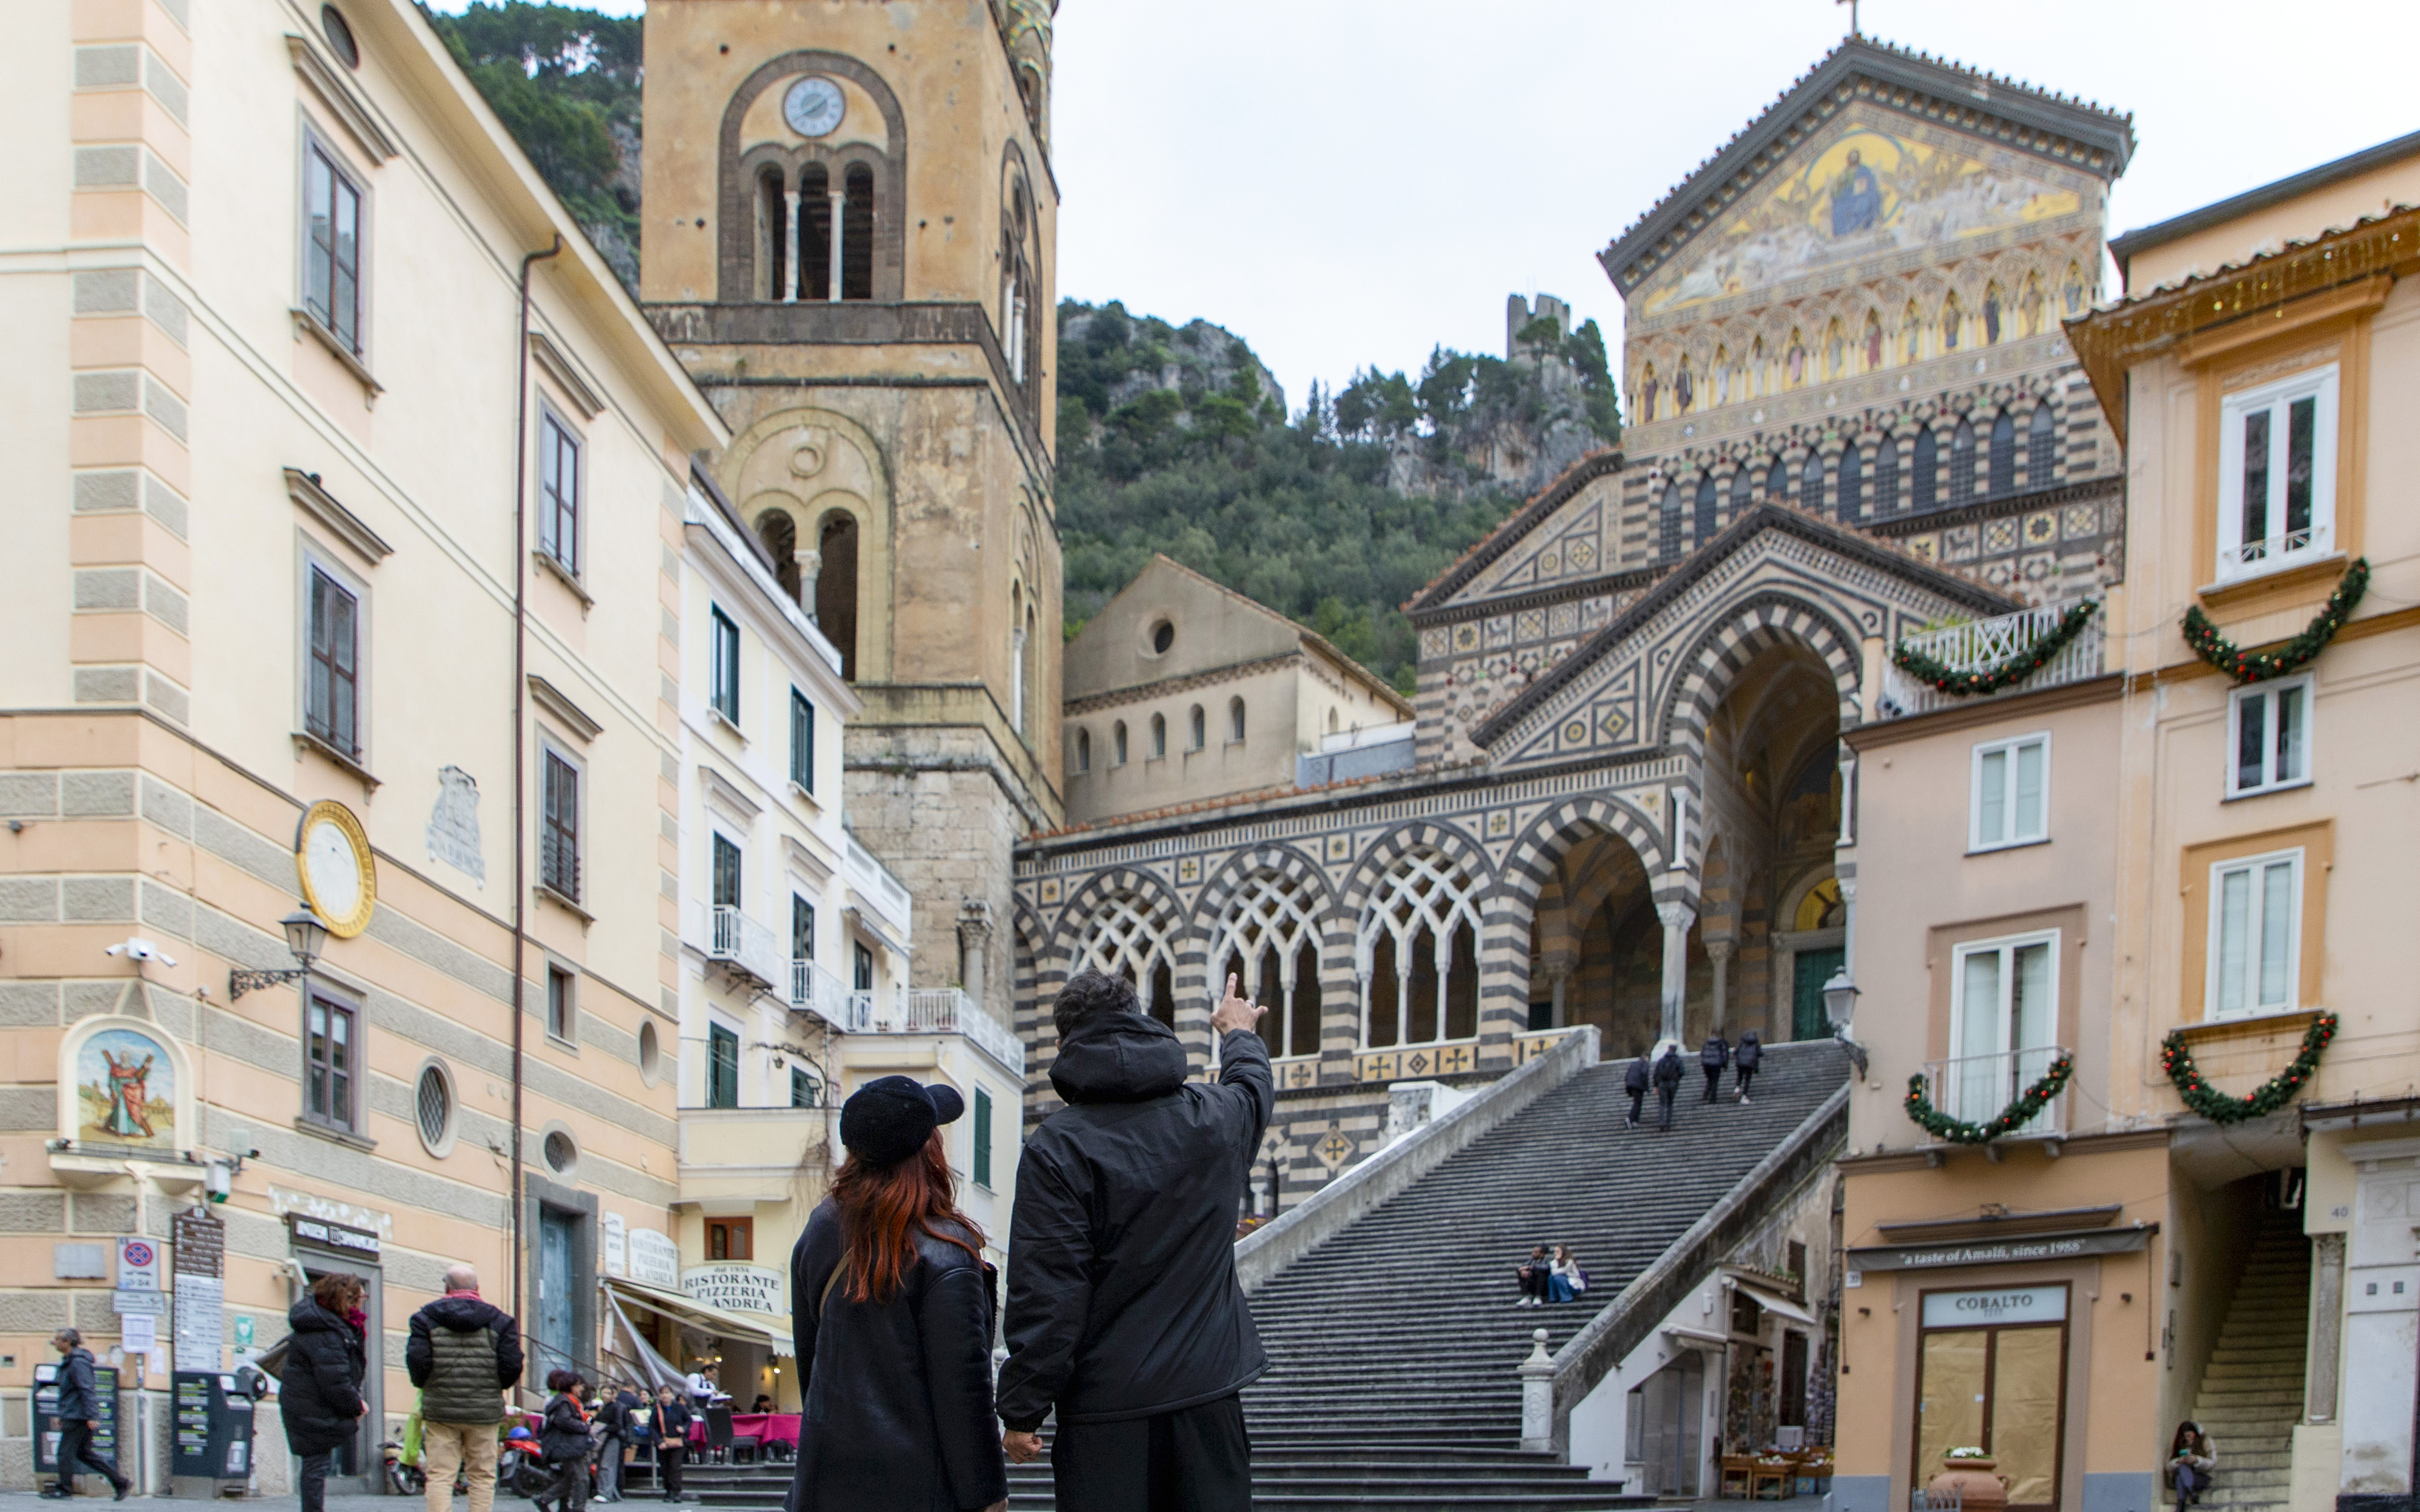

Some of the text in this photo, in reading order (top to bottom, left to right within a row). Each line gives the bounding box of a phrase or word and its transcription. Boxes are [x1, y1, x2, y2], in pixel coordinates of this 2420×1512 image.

[2332, 1206, 2348, 1218] 40
[1915, 1252, 1945, 1264] taste
[1946, 1248, 1961, 1262] of
[2012, 1244, 2047, 1258] since
[684, 1274, 779, 1290] RISTORANTE
[697, 1286, 766, 1299] PIZZERIA
[711, 1298, 773, 1312] ANDREA
[1956, 1294, 2033, 1310] COBALTO
